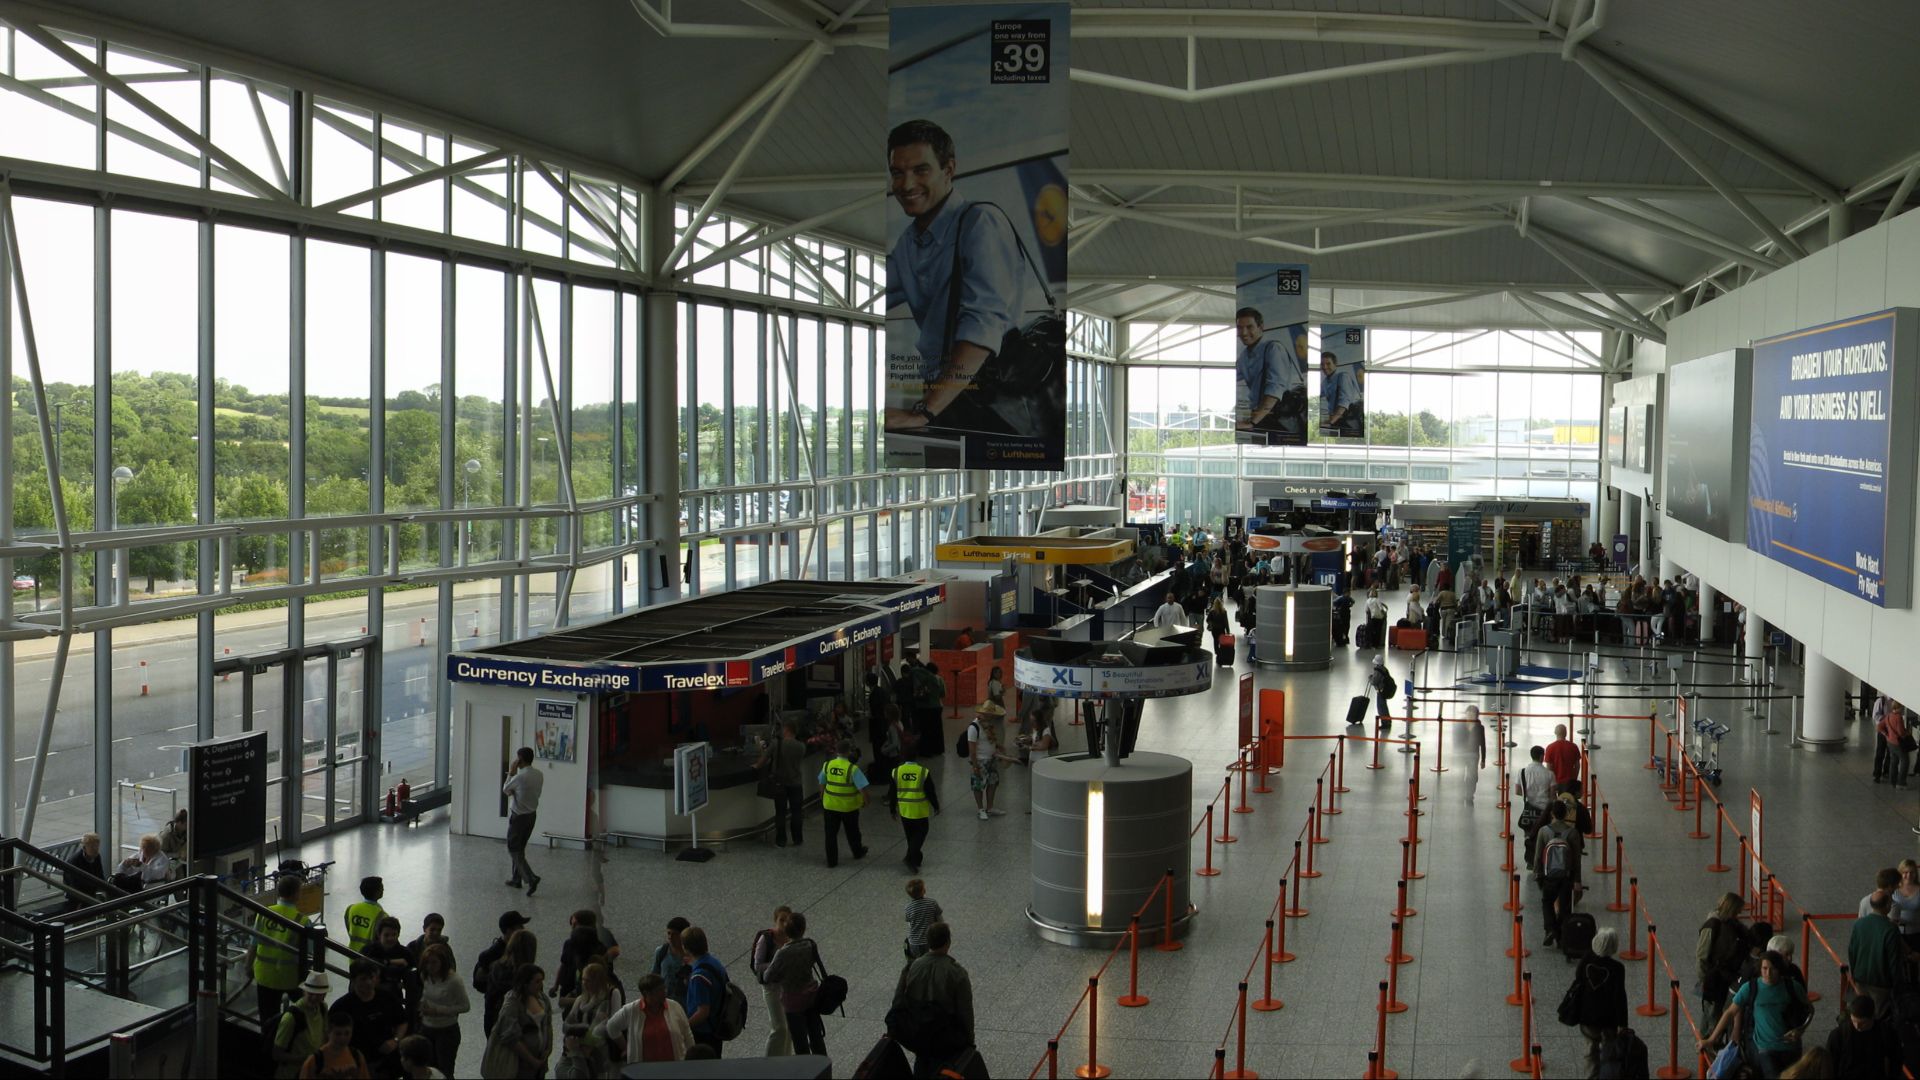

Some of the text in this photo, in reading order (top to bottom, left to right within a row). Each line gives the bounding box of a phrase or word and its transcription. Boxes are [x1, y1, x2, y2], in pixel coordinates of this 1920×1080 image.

[994, 44, 1045, 72] £39
[994, 73, 1025, 81] including
[1792, 341, 1888, 380] BROADEN YOUR HORIZONS.
[1780, 390, 1886, 420] AND YOUR BUSINESS AS WELL.
[1003, 450, 1045, 459] Lufthansa
[1285, 486, 1307, 494] Check
[900, 597, 922, 613] Exchange
[820, 635, 850, 654] Currency
[853, 625, 882, 642] Exchange
[458, 662, 630, 690] Currency Exchange
[761, 660, 785, 679] Travelex
[1052, 667, 1083, 686] XL
[664, 673, 725, 689] Travelex
[540, 710, 560, 718] Currency
